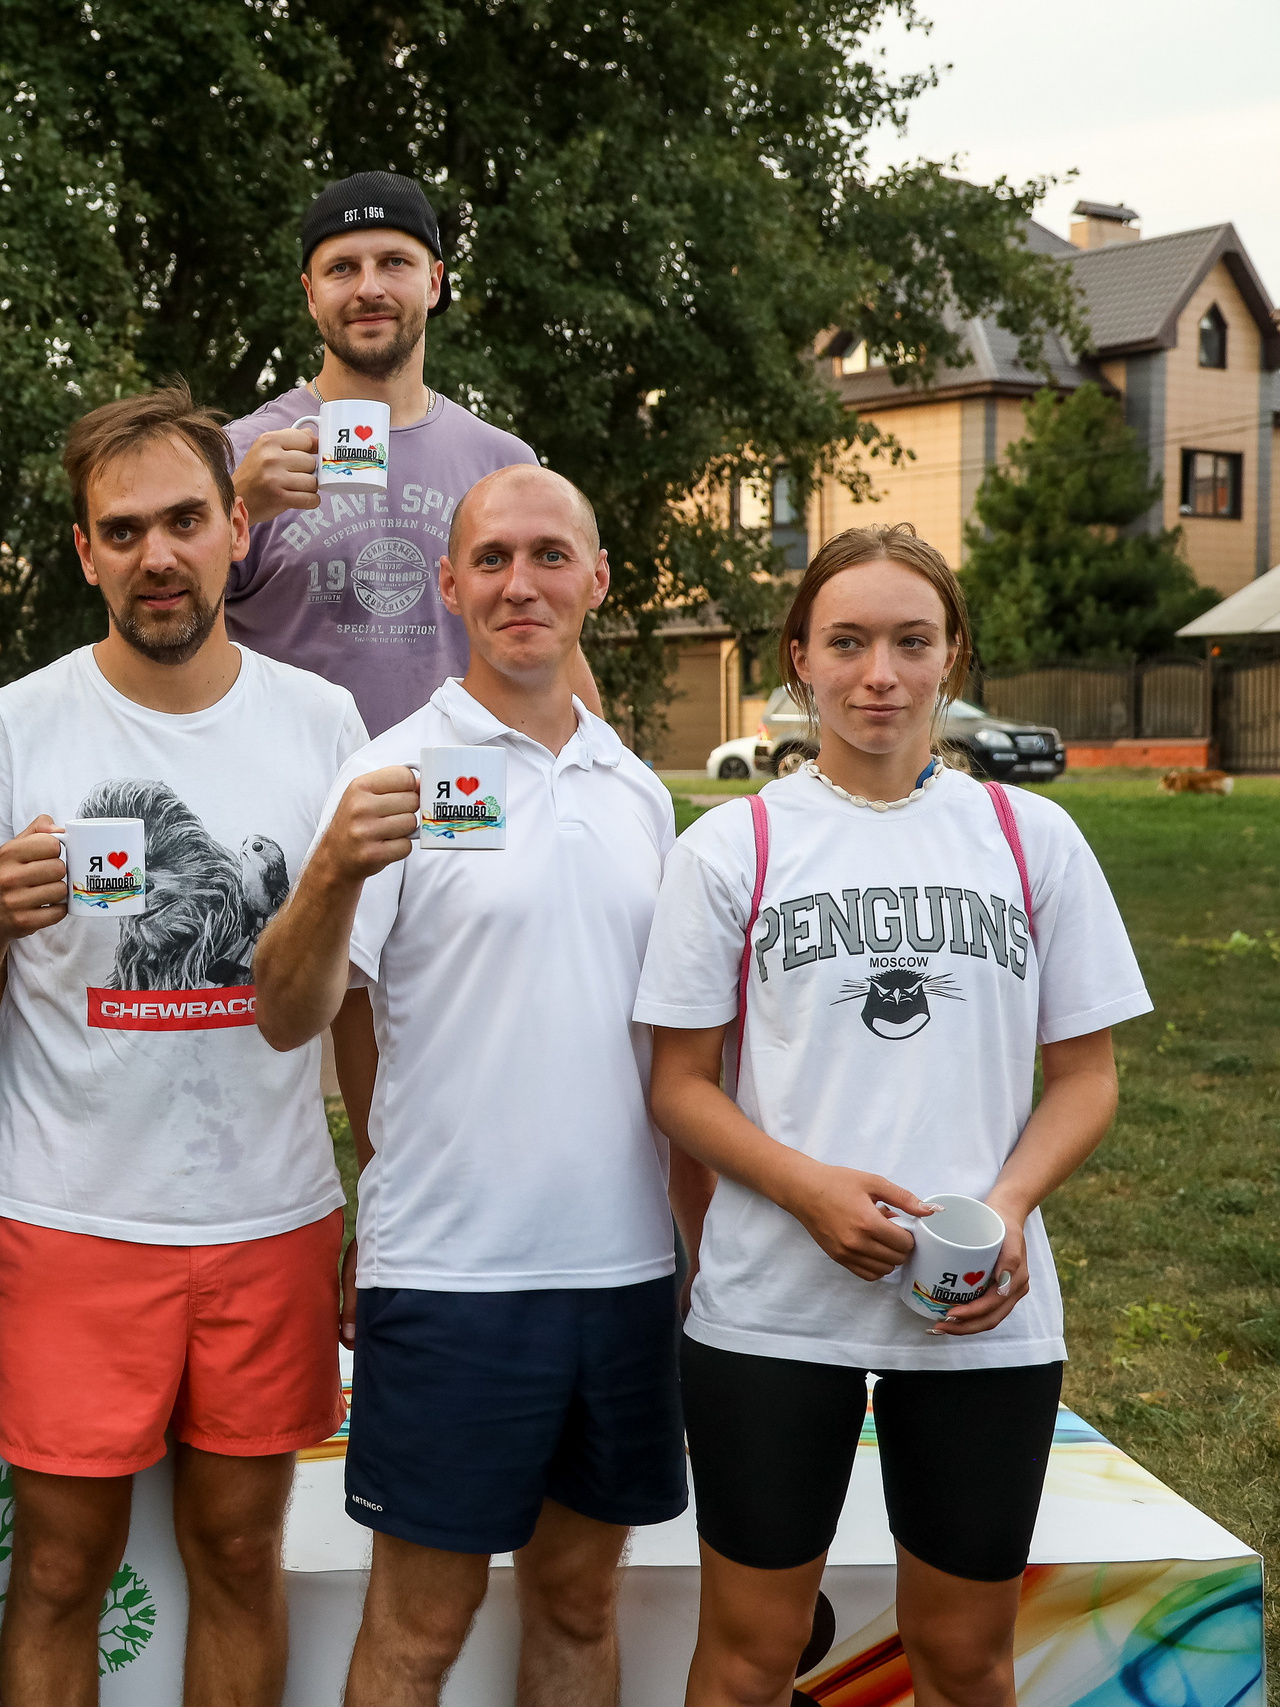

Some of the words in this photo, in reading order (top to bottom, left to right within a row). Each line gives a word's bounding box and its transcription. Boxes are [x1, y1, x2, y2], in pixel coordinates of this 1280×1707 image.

[344, 208, 361, 222] EST.
[363, 206, 385, 219] 1956
[337, 428, 350, 443] Я
[336, 448, 377, 460] ПОТАПОВО
[280, 492, 389, 551] BRAVE
[401, 483, 455, 525] SPI
[323, 519, 376, 548] SUPERIOR
[380, 518, 419, 529] URBAN
[366, 543, 417, 560] CHALLENGE
[306, 560, 346, 592] 19
[357, 570, 387, 582] URBAN
[389, 571, 423, 583] BRAND
[336, 624, 384, 634] SPECIAL
[390, 625, 437, 635] EDITION
[436, 781, 450, 799] Я
[436, 805, 486, 818] ПОТАПОВО
[89, 856, 103, 872] Я
[90, 876, 134, 890] ПОТАПОВО
[755, 886, 1030, 983] PENGUINS
[869, 956, 929, 968] MOSCOW
[939, 1272, 958, 1287] Я
